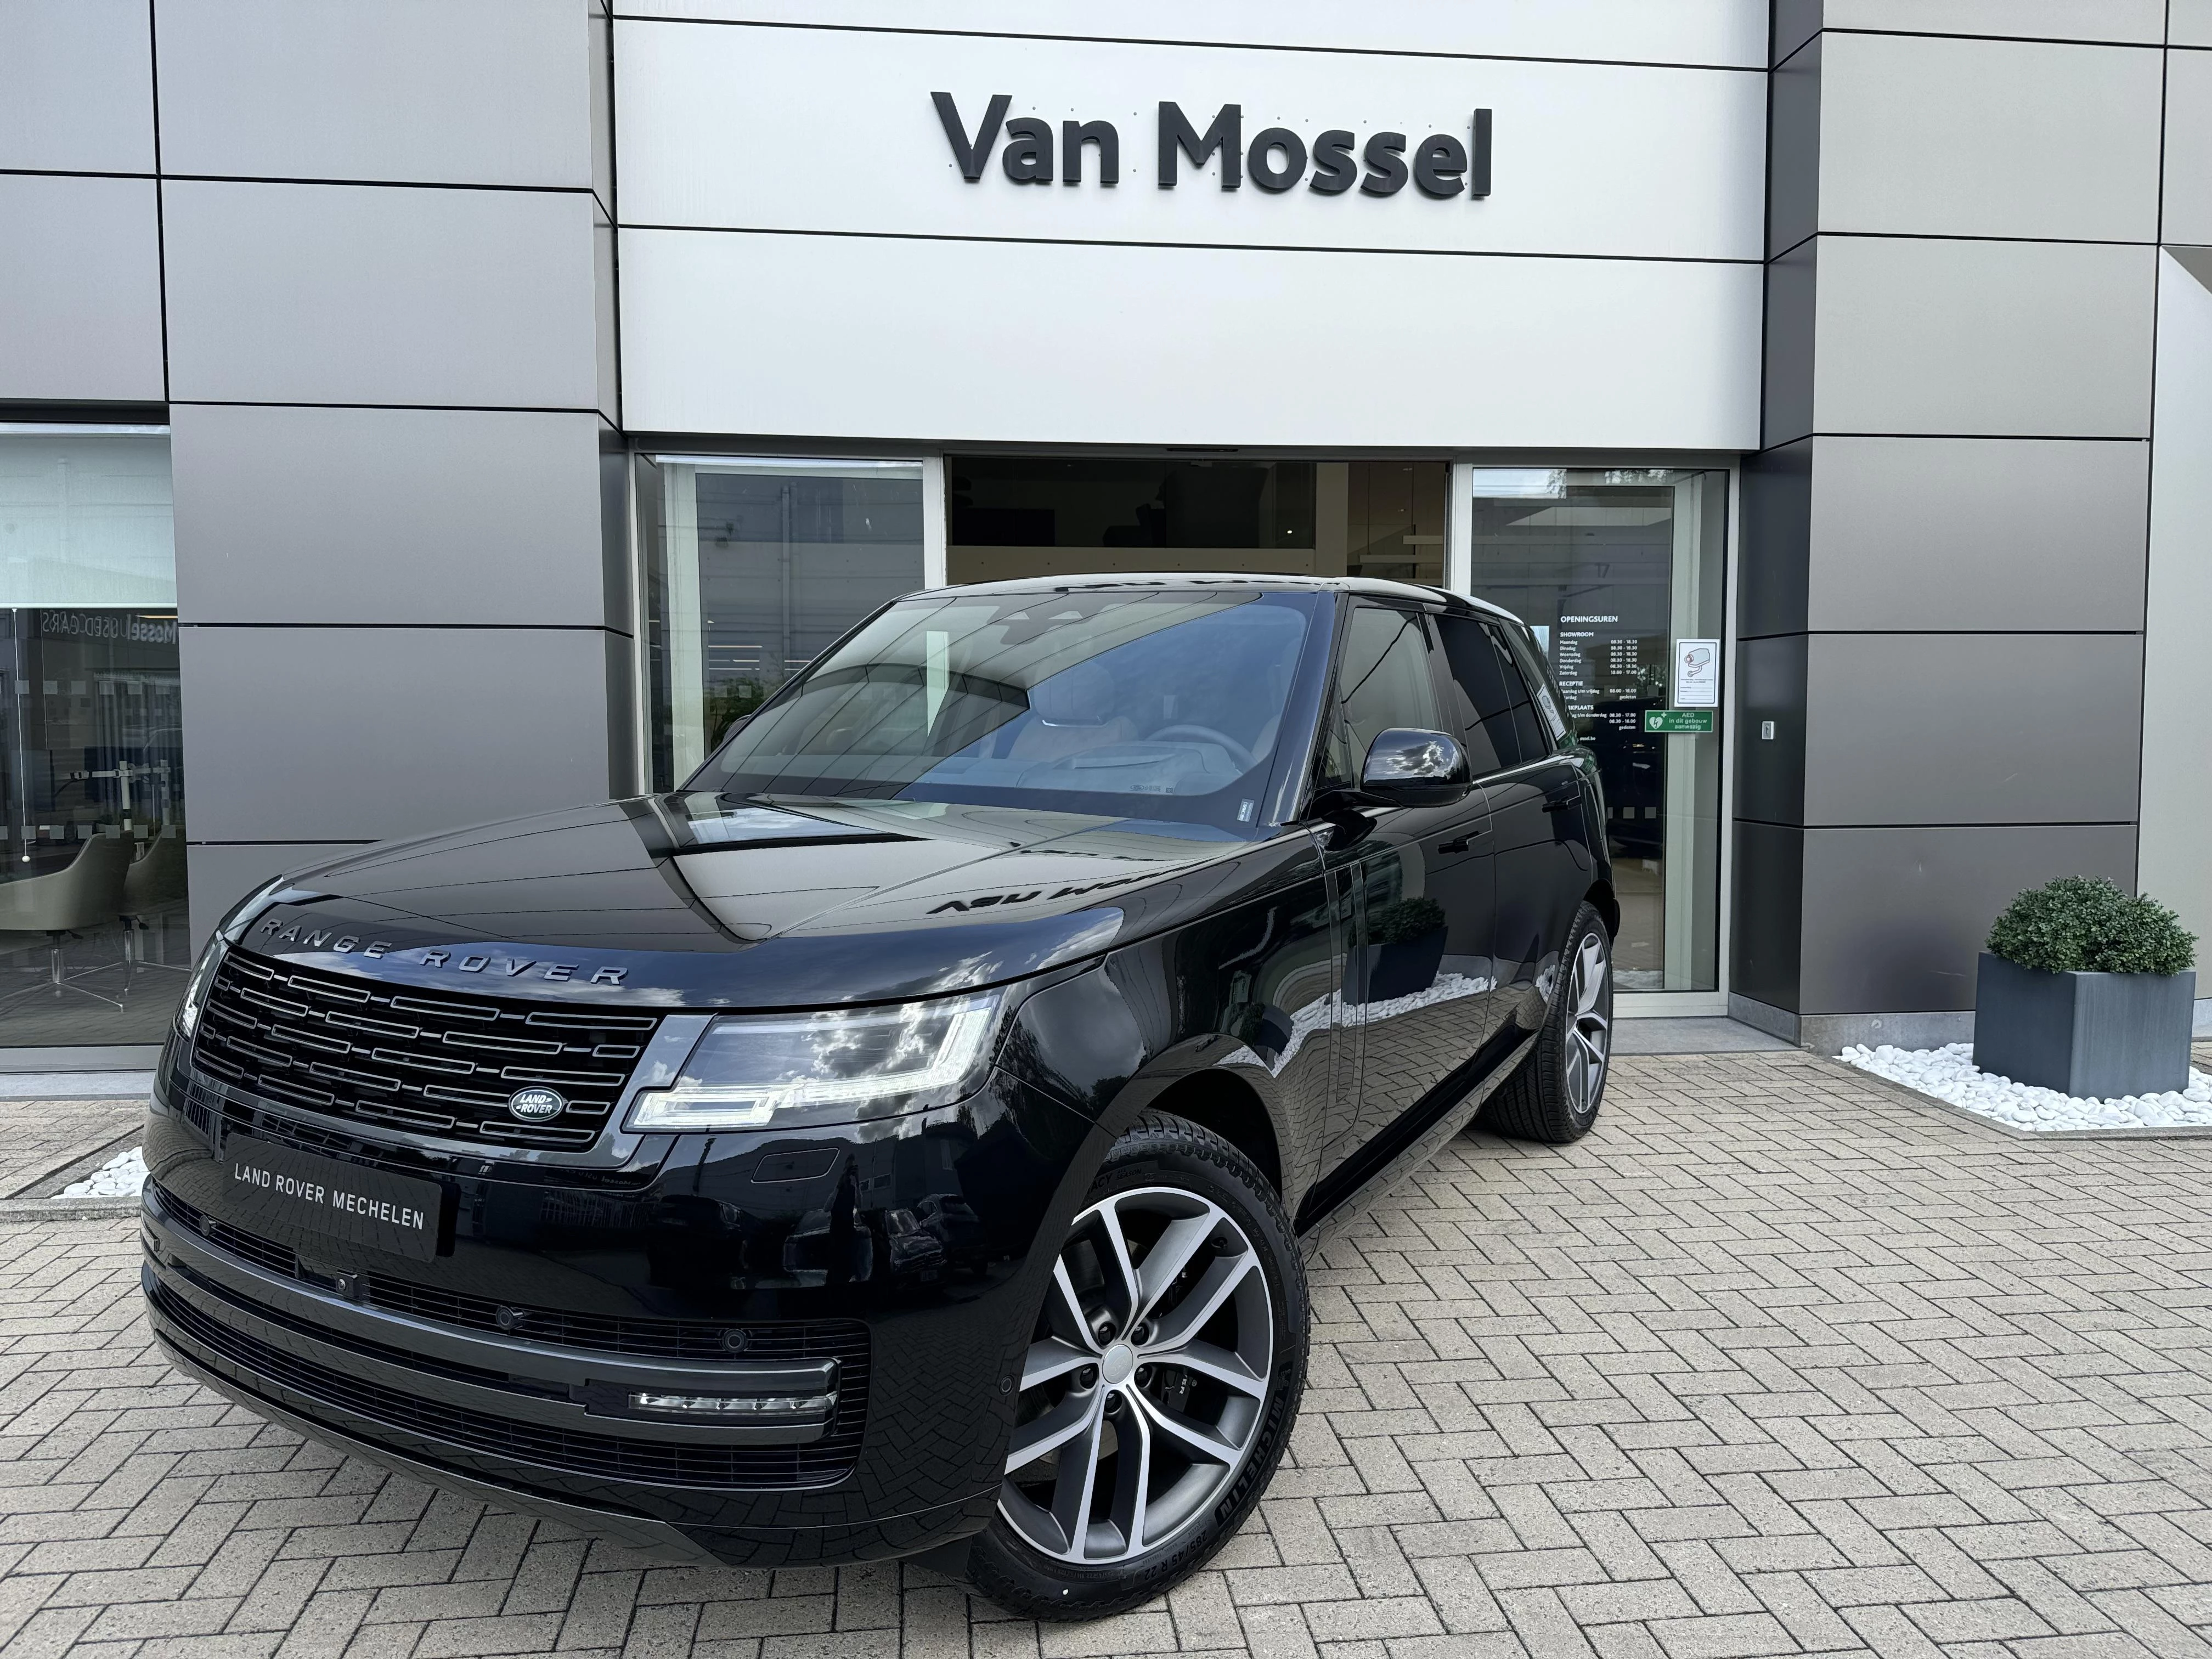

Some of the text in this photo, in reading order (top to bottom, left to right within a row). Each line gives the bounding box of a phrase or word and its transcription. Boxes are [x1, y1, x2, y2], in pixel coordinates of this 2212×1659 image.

[931, 92, 1492, 200] Van Mossel
[260, 918, 629, 985] RANGE ROVER
[520, 1094, 547, 1104] LAND
[520, 1104, 553, 1114] ROVER
[235, 1163, 424, 1229] LAND ROVER MECHELEN
[1220, 1396, 1284, 1517] MICHELIN
[1161, 1559, 1167, 1572] R
[1172, 1530, 1207, 1566] 285/45
[1144, 1565, 1157, 1581] 22
